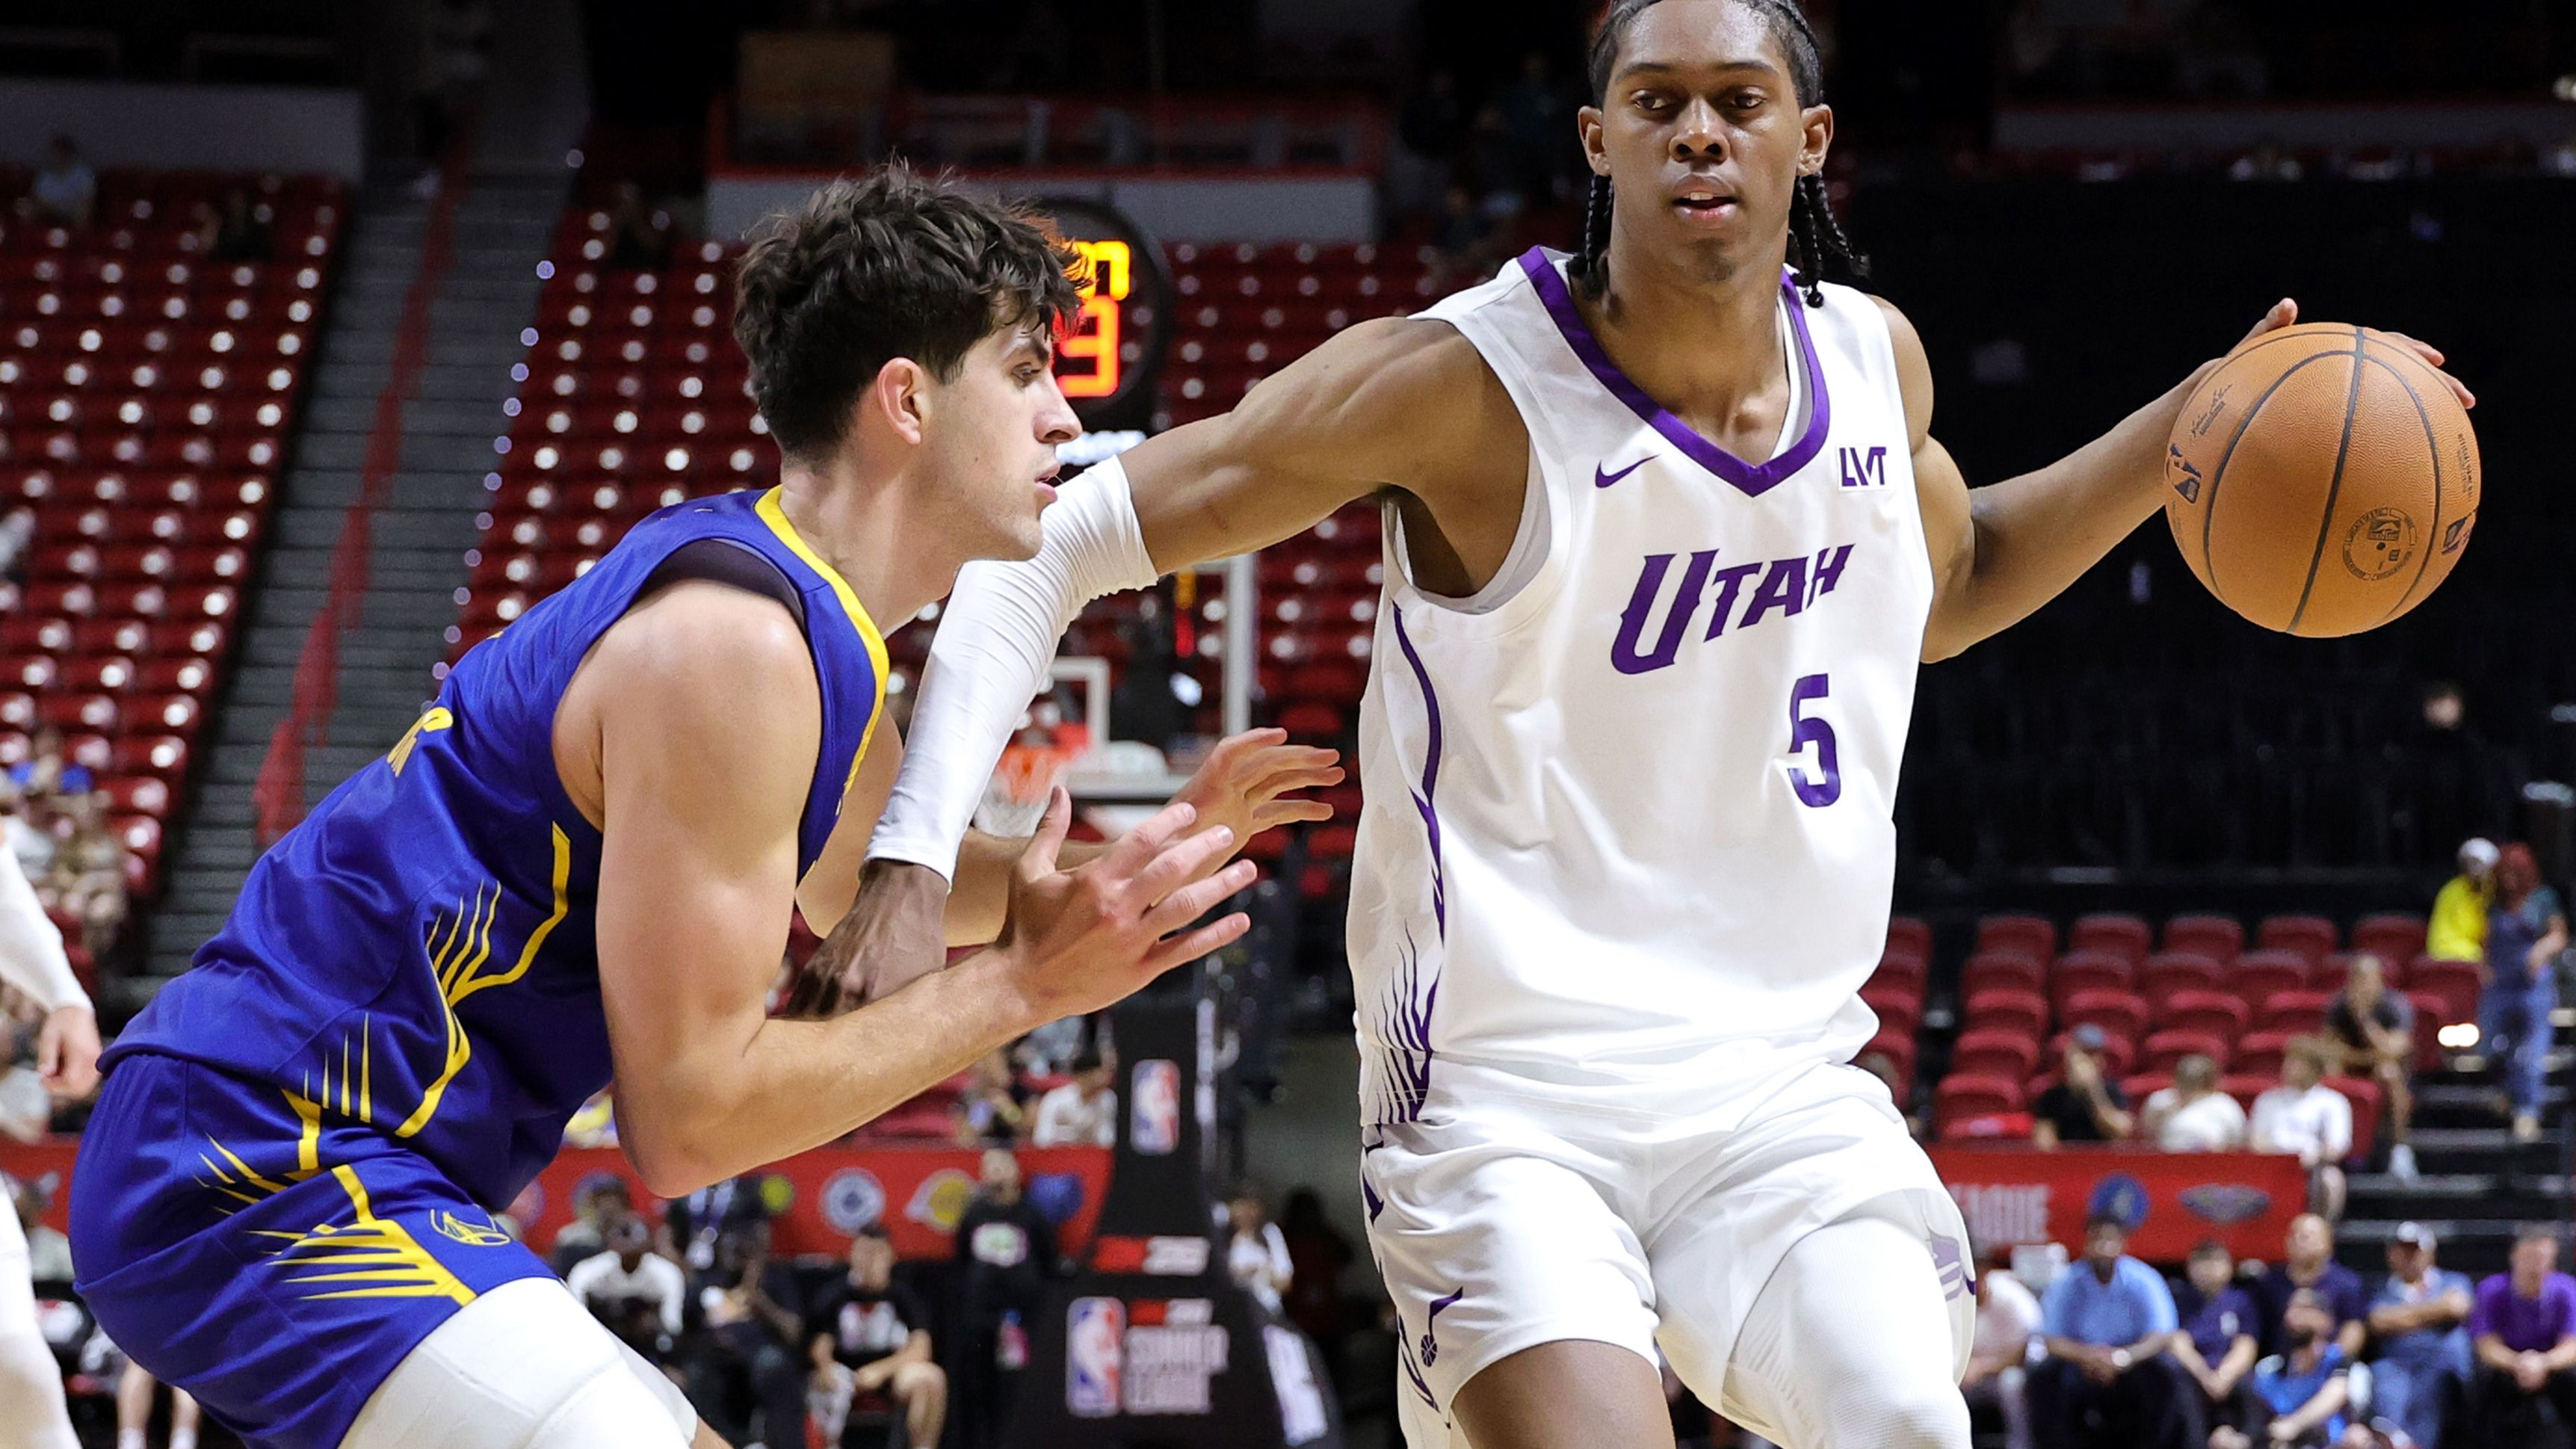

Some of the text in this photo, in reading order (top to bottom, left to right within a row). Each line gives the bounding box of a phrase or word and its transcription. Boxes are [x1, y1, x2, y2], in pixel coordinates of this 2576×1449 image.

[1838, 446, 1887, 488] LVT
[1610, 543, 1856, 676] UTAH
[1787, 673, 1841, 809] 5
